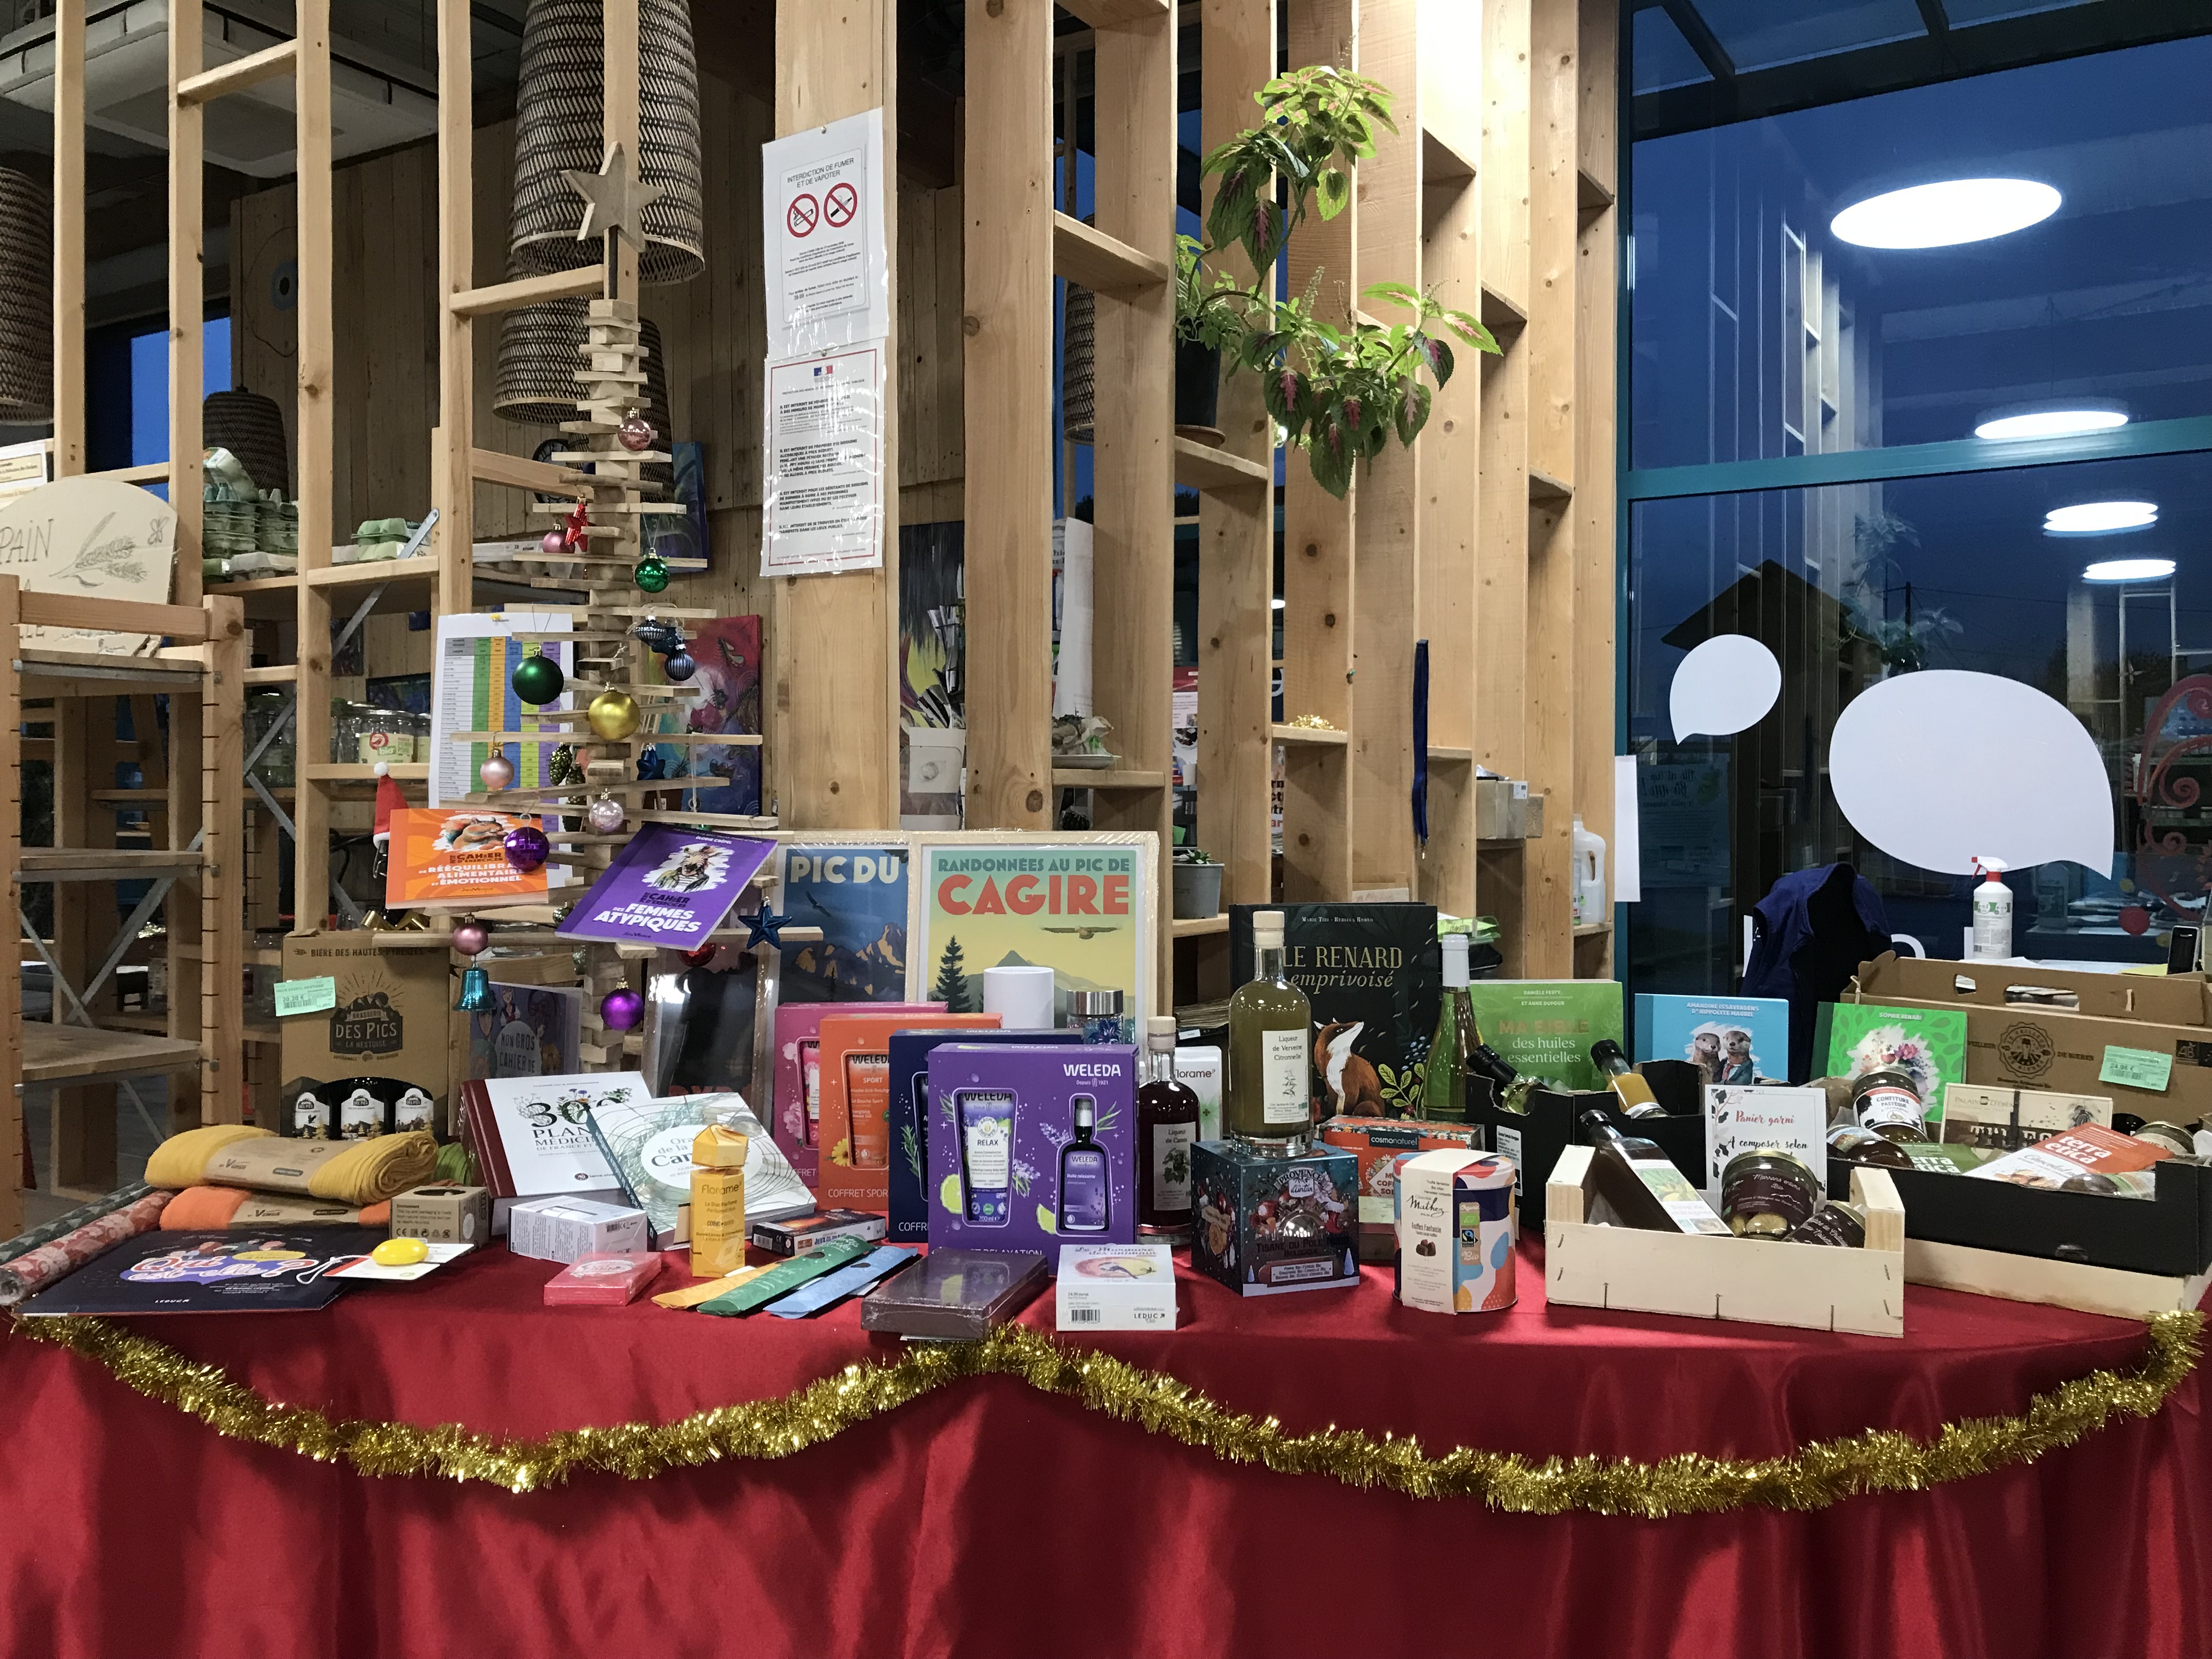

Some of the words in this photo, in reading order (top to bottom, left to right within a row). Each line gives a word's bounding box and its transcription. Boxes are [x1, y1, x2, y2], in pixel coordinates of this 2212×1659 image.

[787, 167, 824, 183] INTERDICTION
[834, 157, 854, 168] FUMER
[814, 170, 840, 182] VAPOTER
[428, 862, 517, 872] RÉÉQUILIBRA
[791, 856, 847, 883] PIC
[853, 856, 899, 883] DU
[938, 857, 1043, 871] RANDONNÉES
[1048, 858, 1070, 871] AU
[1076, 858, 1103, 871] PIC
[1109, 858, 1129, 871] DE
[439, 876, 522, 885] ÉMOTIONNEL
[649, 893, 691, 904] CAHIER
[938, 874, 1129, 915] CAGIRE
[625, 903, 696, 919] FEMMES
[593, 911, 702, 933] ATYPIQUES
[1282, 946, 1306, 967] LE
[1316, 946, 1402, 969] RENARD
[1686, 1001, 1718, 1010] AMANDINE
[335, 1024, 361, 1039] DES
[366, 1022, 397, 1037] PICS
[501, 1034, 514, 1048] MON
[516, 1033, 535, 1051] GROS
[1512, 1037, 1534, 1048] des
[1538, 1037, 1576, 1048] huiles
[1508, 1051, 1581, 1063] essentielles
[2177, 1046, 2195, 1058] AB
[500, 1052, 526, 1071] CAHIER
[528, 1059, 535, 1073] DE
[1063, 1064, 1121, 1077] WELEDA
[964, 1093, 1012, 1101] WELEDA
[1876, 1096, 1909, 1104] CONFITURE
[1736, 1110, 1765, 1124] Panier
[1768, 1115, 1795, 1126] garni
[532, 1126, 591, 1138] PLAN
[1371, 1137, 1417, 1146] cosmonaturel
[1728, 1136, 1735, 1149] A
[1740, 1139, 1781, 1150] composer
[1785, 1138, 1808, 1149] selon
[2058, 1136, 2112, 1159] terra
[2045, 1141, 2098, 1164] etica
[1915, 1156, 1954, 1165] erra
[1919, 1164, 1962, 1173] tica
[1279, 1169, 1322, 1184] PROVENCE
[828, 1189, 865, 1198] COFFRET
[867, 1189, 889, 1197] SPOR
[1406, 1195, 1449, 1218] Mathez
[899, 1222, 928, 1231] COFFR
[1424, 1224, 1441, 1233] Fantaisie
[1256, 1242, 1285, 1252] TISANE
[1462, 1251, 1479, 1261] Bio
